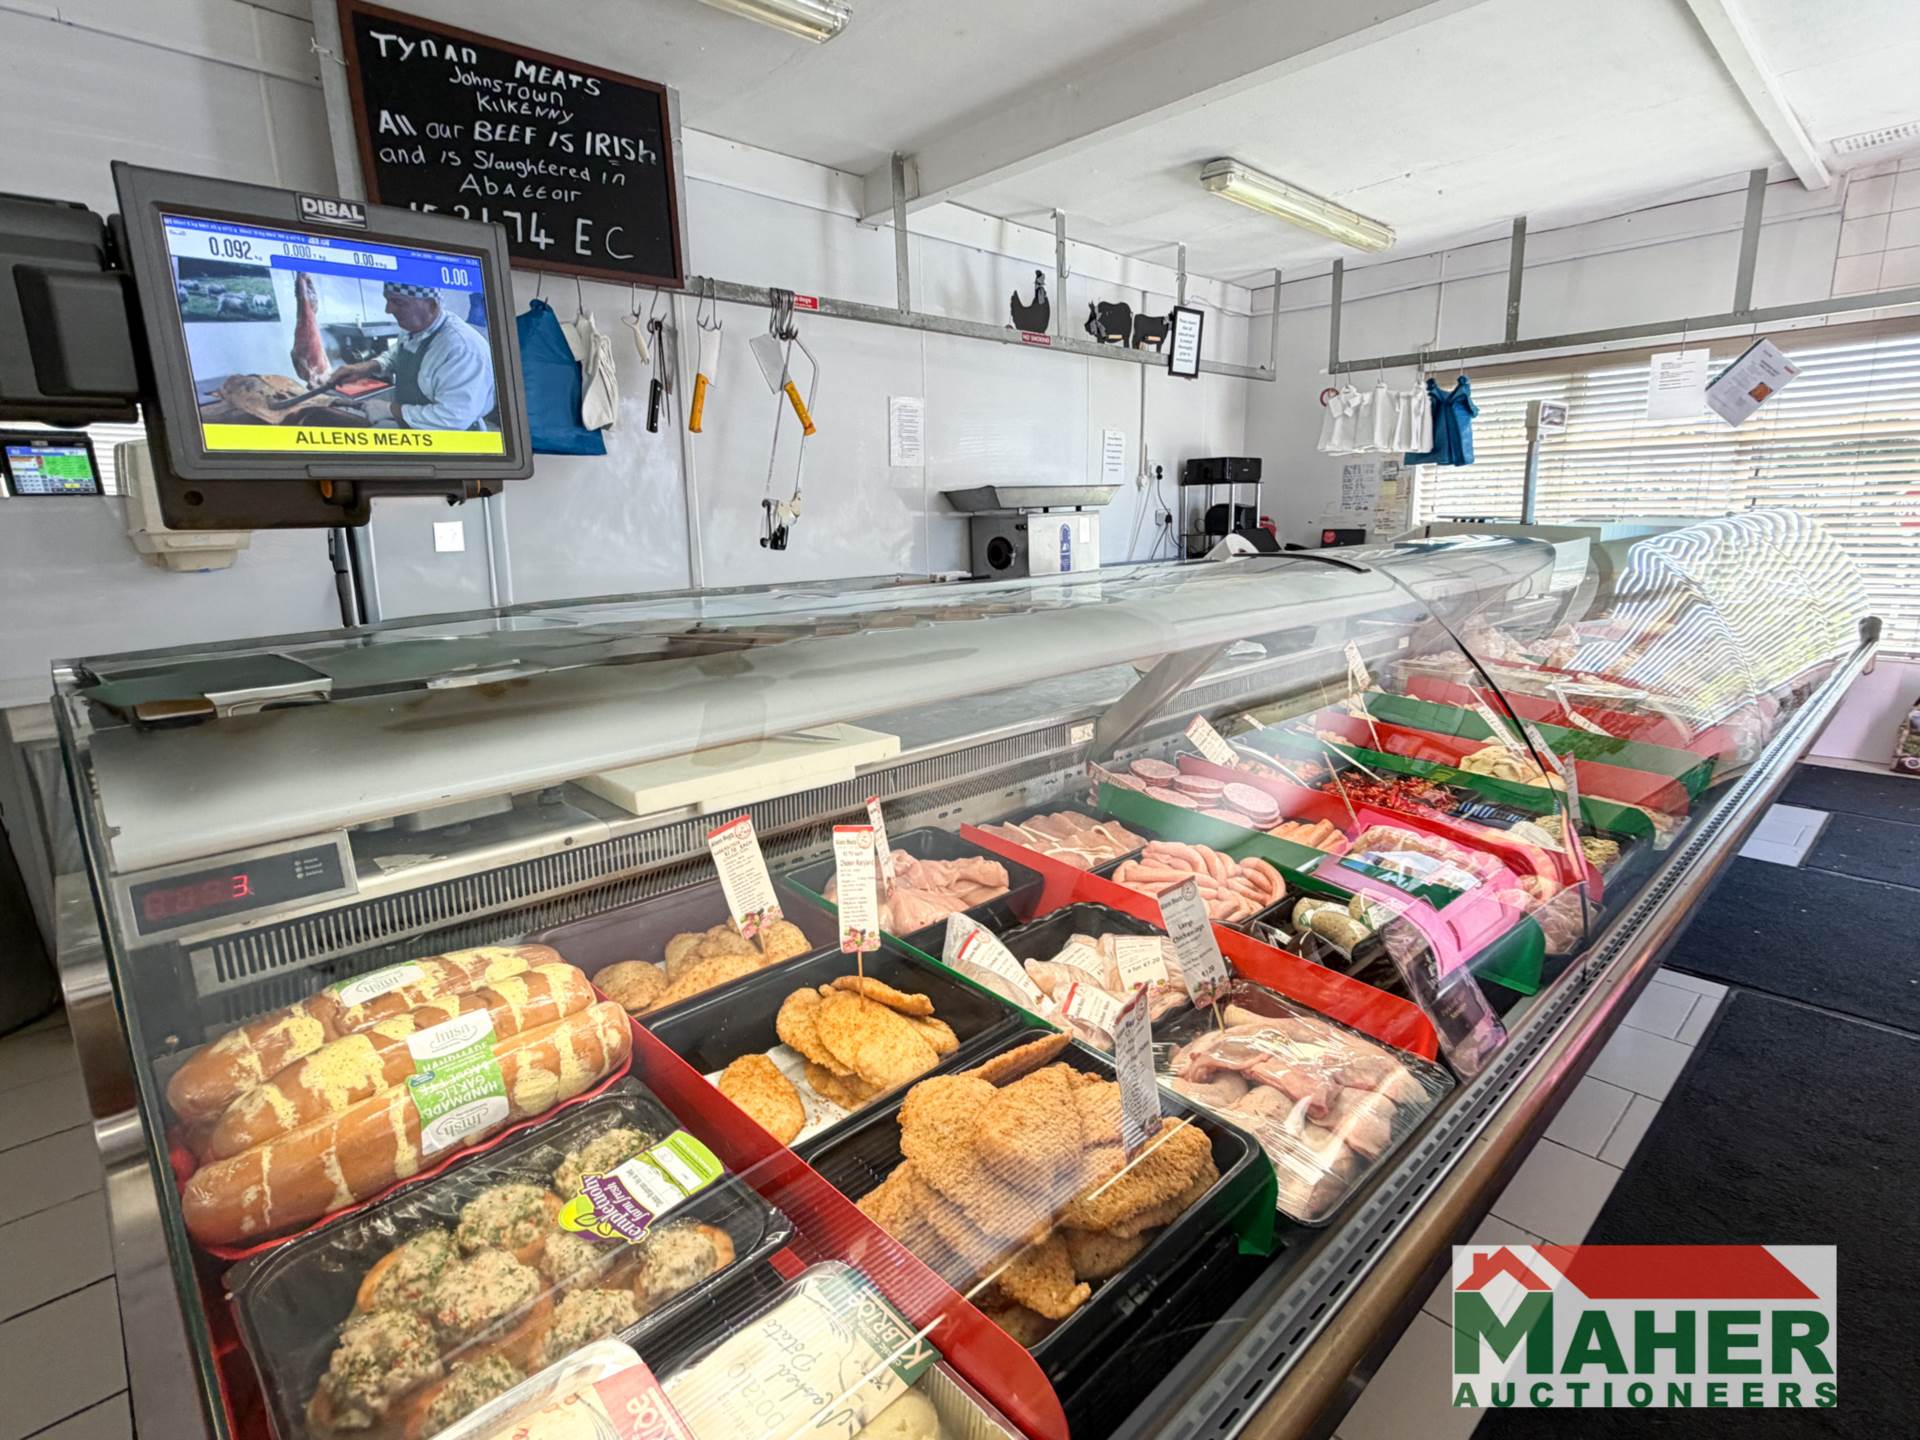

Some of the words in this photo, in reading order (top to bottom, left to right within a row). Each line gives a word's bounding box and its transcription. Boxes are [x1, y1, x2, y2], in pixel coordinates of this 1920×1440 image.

[514, 60, 601, 97] MEATS
[379, 109, 417, 136] All
[425, 121, 464, 139] our
[473, 119, 537, 145] BEEF
[549, 131, 574, 153] IS
[379, 144, 425, 164] and
[440, 150, 461, 166] is
[473, 149, 591, 183] Slaughtered
[602, 172, 626, 187] in
[301, 197, 365, 221] DIBAL
[209, 236, 253, 261] 0.092
[283, 243, 312, 259] 0.000
[353, 252, 374, 266] 0.00
[441, 266, 469, 287] 0.00
[296, 431, 369, 446] ALLENS
[374, 433, 433, 447] MEATS
[231, 874, 249, 899] 3
[422, 1080, 498, 1119] HANDMADE
[436, 1074, 485, 1101] GARLIC
[443, 1113, 482, 1138] Inish
[604, 1181, 629, 1204] fresh
[581, 1174, 648, 1242] templetuohy
[621, 1200, 650, 1222] farm
[762, 1318, 823, 1373] Potato
[763, 1363, 854, 1430] Mashed
